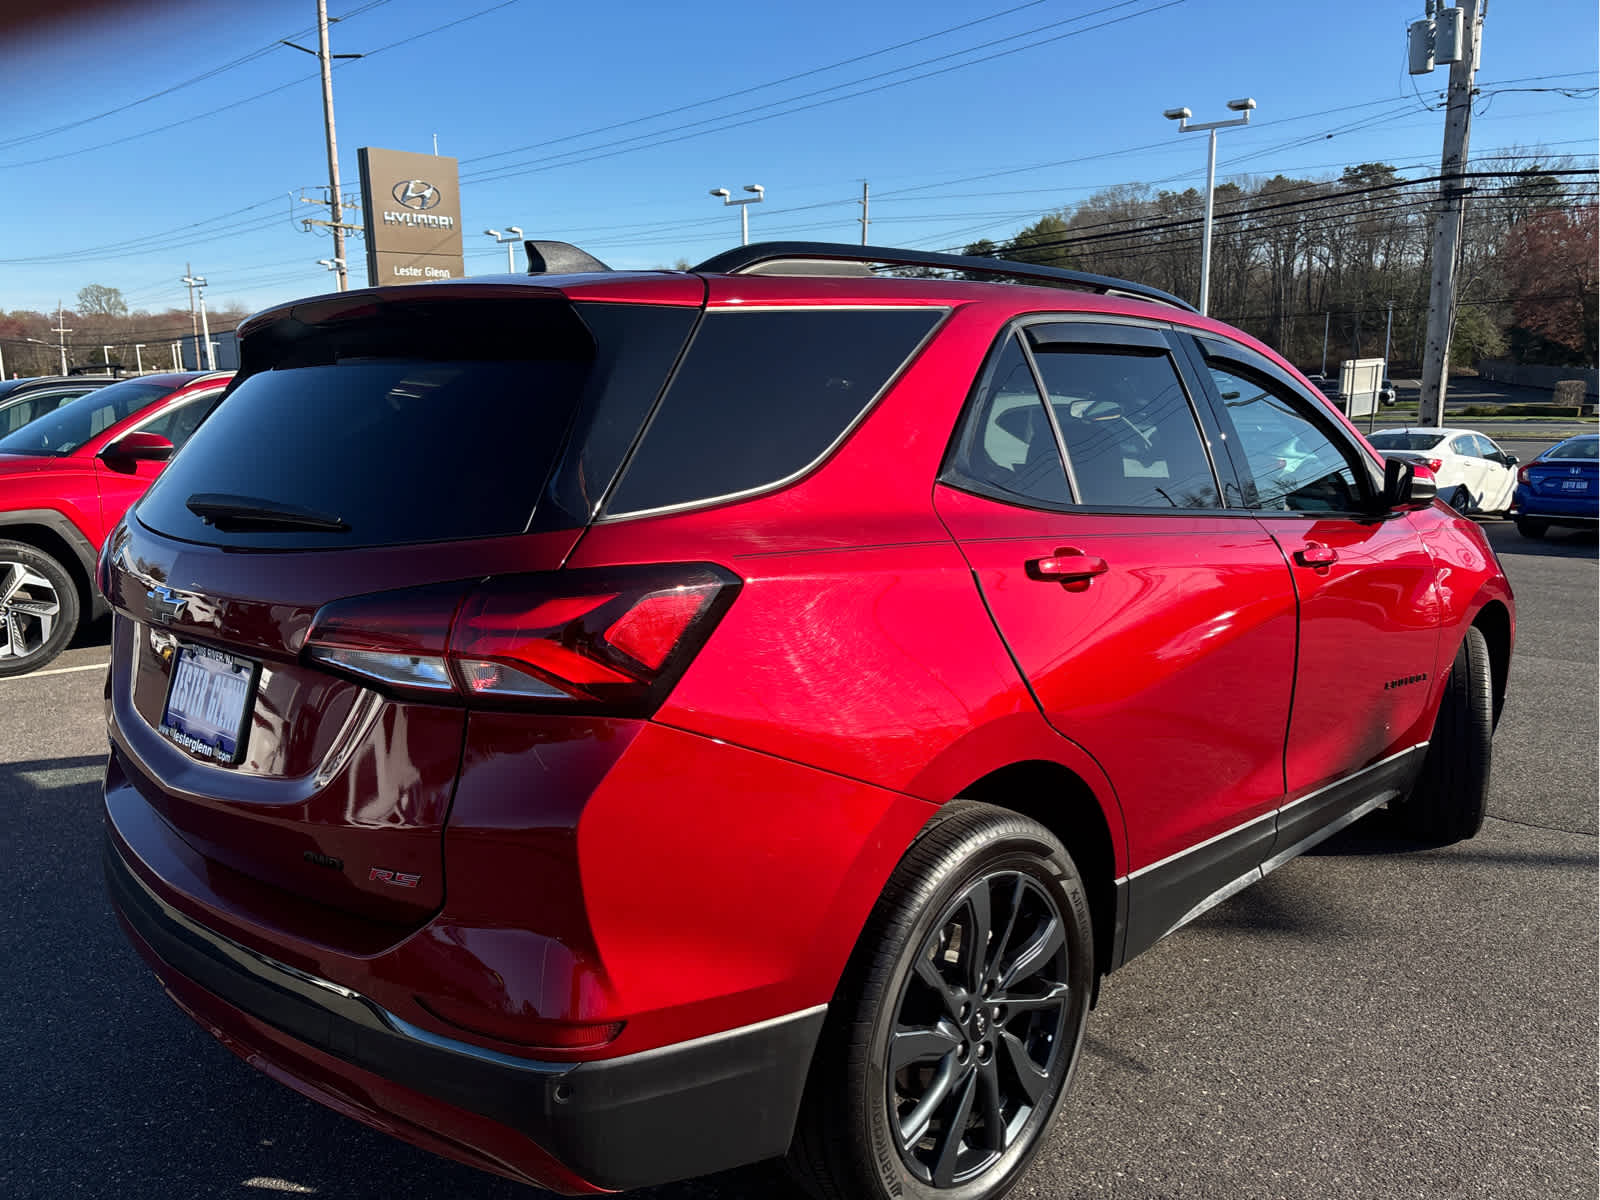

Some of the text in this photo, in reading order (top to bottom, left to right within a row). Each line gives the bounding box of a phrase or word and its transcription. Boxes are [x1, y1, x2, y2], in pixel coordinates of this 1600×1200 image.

[383, 210, 454, 230] HYUNDAI
[393, 265, 451, 279] Lester Glenn
[169, 660, 211, 719] LESTER
[368, 867, 421, 888] RS
